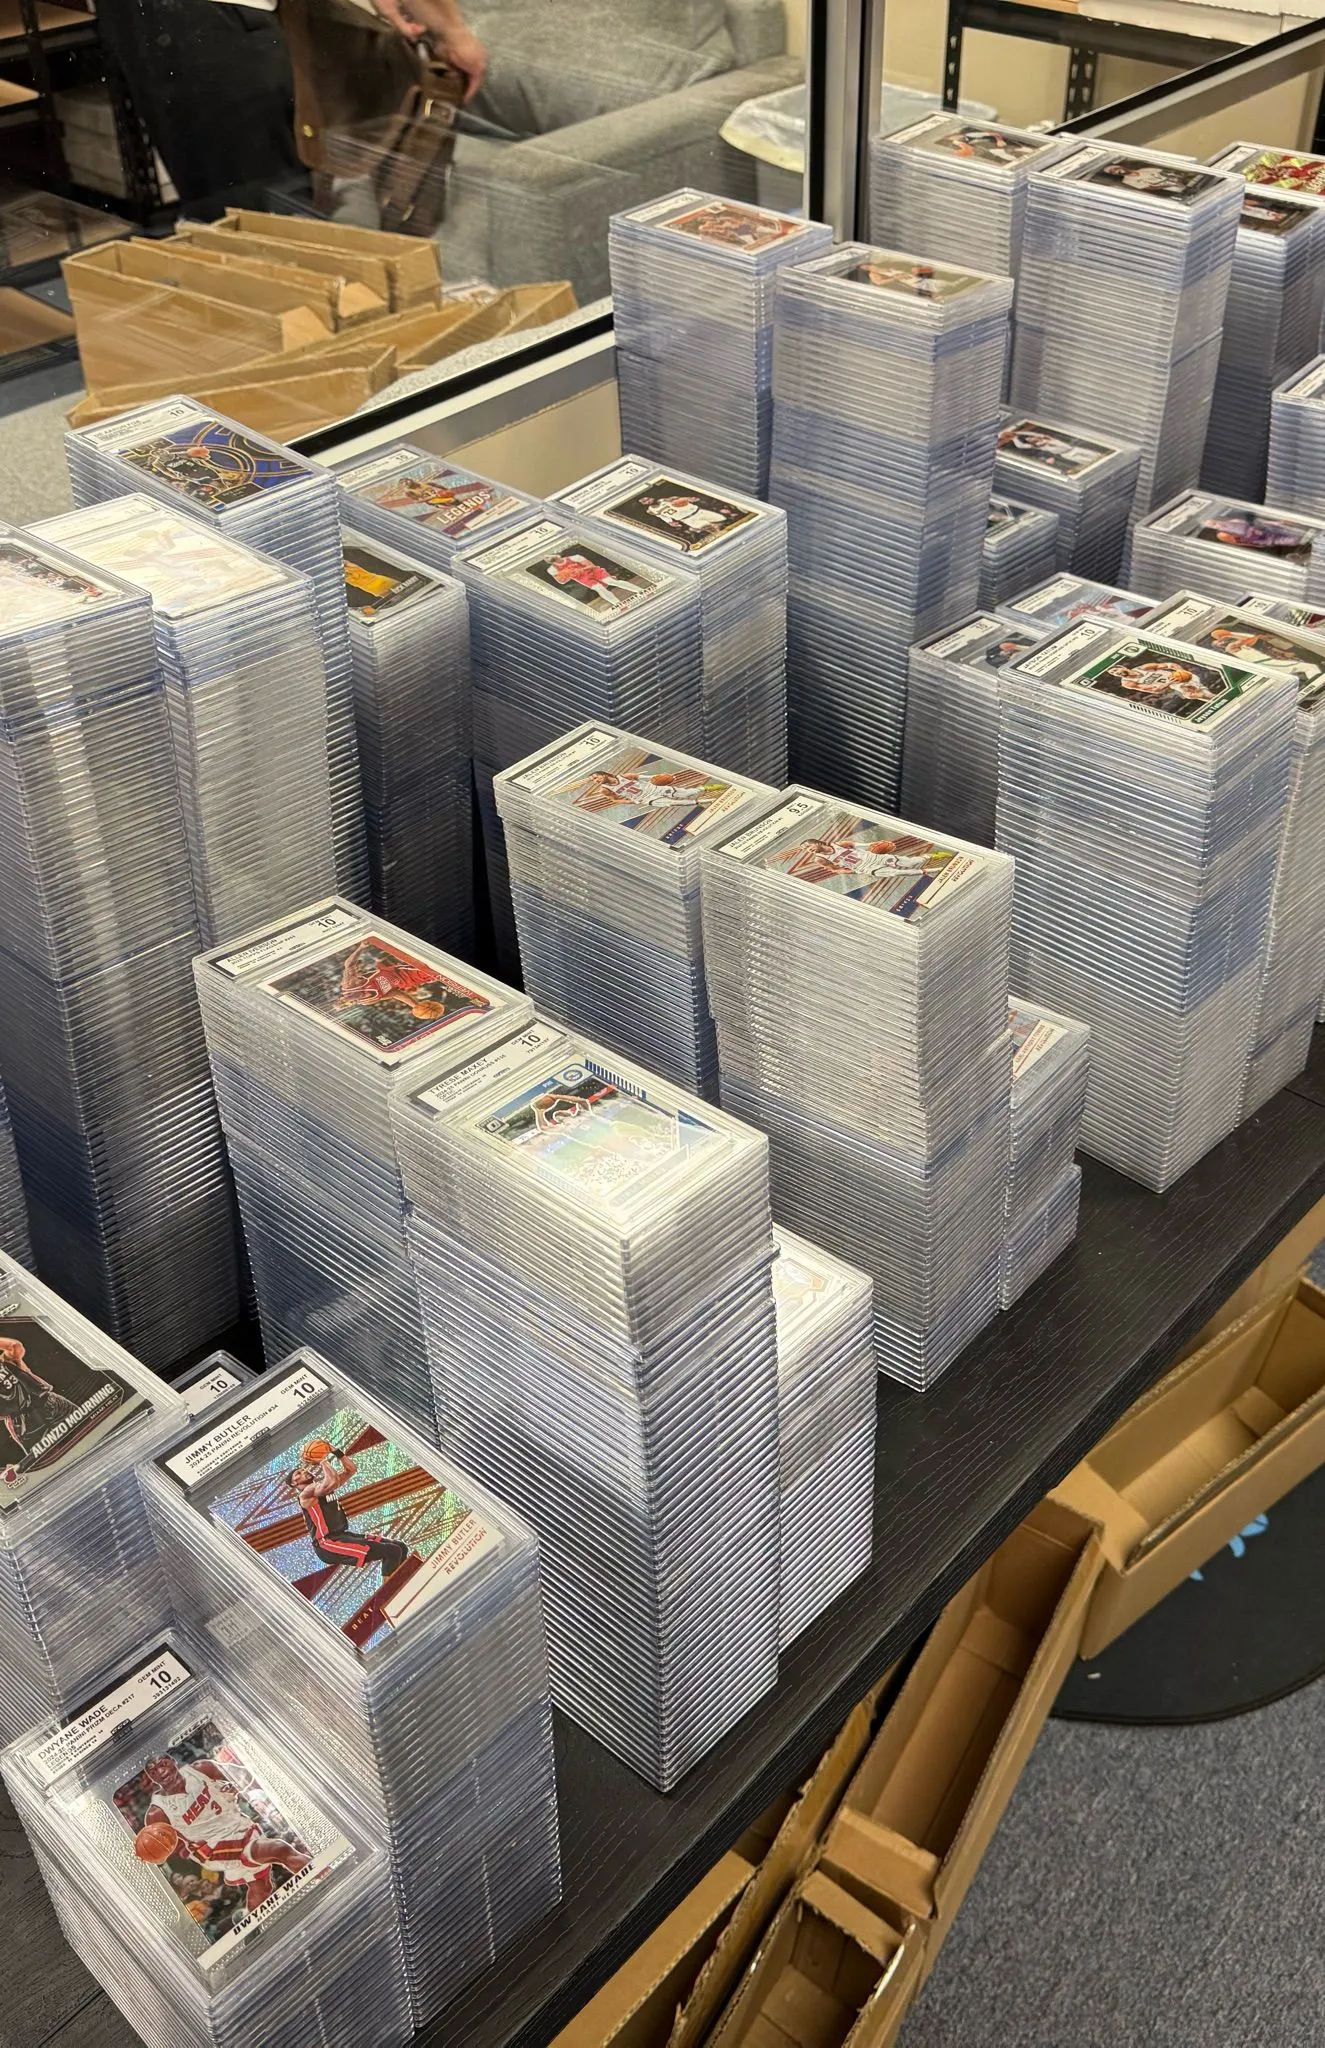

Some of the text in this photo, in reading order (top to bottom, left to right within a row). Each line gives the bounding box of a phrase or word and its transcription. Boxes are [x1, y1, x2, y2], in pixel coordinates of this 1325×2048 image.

[436, 490, 491, 524] LEGENDS
[1078, 628, 1095, 637] 10
[583, 737, 601, 746] 10
[787, 802, 809, 814] 9.5
[315, 917, 337, 928] 10
[518, 1034, 542, 1048] 10
[429, 1074, 461, 1094] TYRESE
[459, 1057, 488, 1075] MAXEY
[3, 1375, 19, 1390] 33
[210, 1380, 228, 1392] 10
[279, 1373, 308, 1394] GEM MINT
[290, 1381, 316, 1400] 10
[30, 1383, 116, 1459] ALONZO MOURNING
[210, 1436, 232, 1453] PANINI
[230, 1410, 269, 1438] REVOLUTION
[181, 1440, 215, 1464] JIMMY
[212, 1414, 251, 1442] BUTLER
[431, 1519, 477, 1569] JIMMY BUTLER
[444, 1527, 488, 1575] REVOLUTION
[136, 1660, 166, 1684] GEM MINT
[146, 1668, 173, 1691] 10
[37, 1726, 79, 1759] DWYANE
[78, 1704, 108, 1728] WADE
[65, 1730, 87, 1747] PANINI
[85, 1715, 106, 1732] PRIZM
[104, 1702, 123, 1718] DECA
[120, 1693, 135, 1705] #217
[46, 1744, 76, 1768] LEGENDS
[182, 1781, 212, 1825] HEAT
[210, 1800, 222, 1815] 3
[232, 1863, 315, 1936] DWYANE WADE
